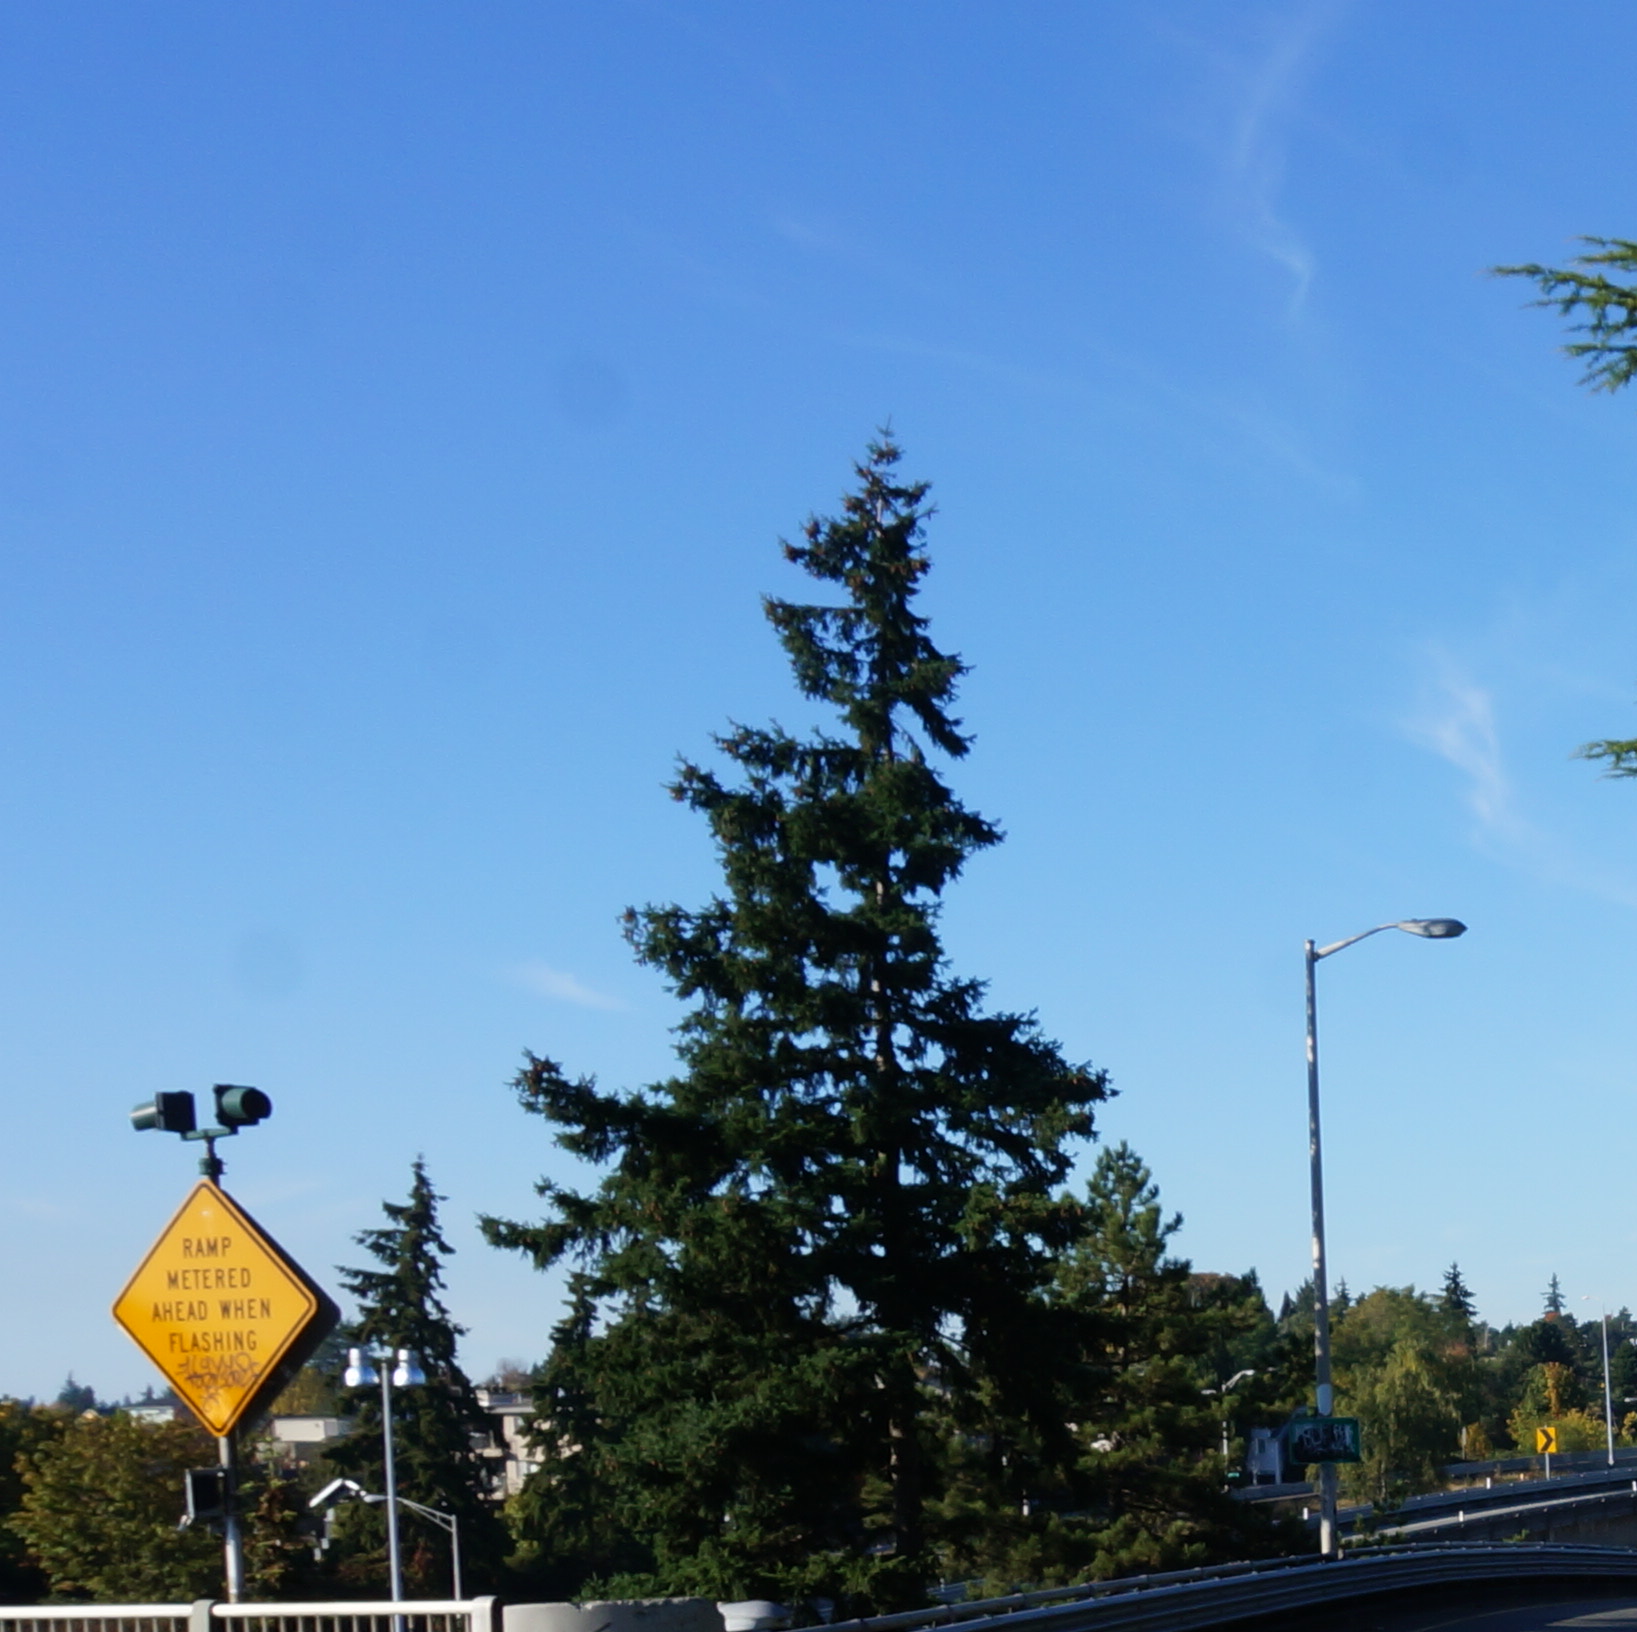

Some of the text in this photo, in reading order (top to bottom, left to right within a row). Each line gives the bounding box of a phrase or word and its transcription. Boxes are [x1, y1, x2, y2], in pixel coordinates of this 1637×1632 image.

[182, 1237, 232, 1259] RAMP
[167, 1267, 252, 1290] METERED
[152, 1298, 272, 1322] AHEAD WHEN
[169, 1330, 258, 1353] FLASHING
